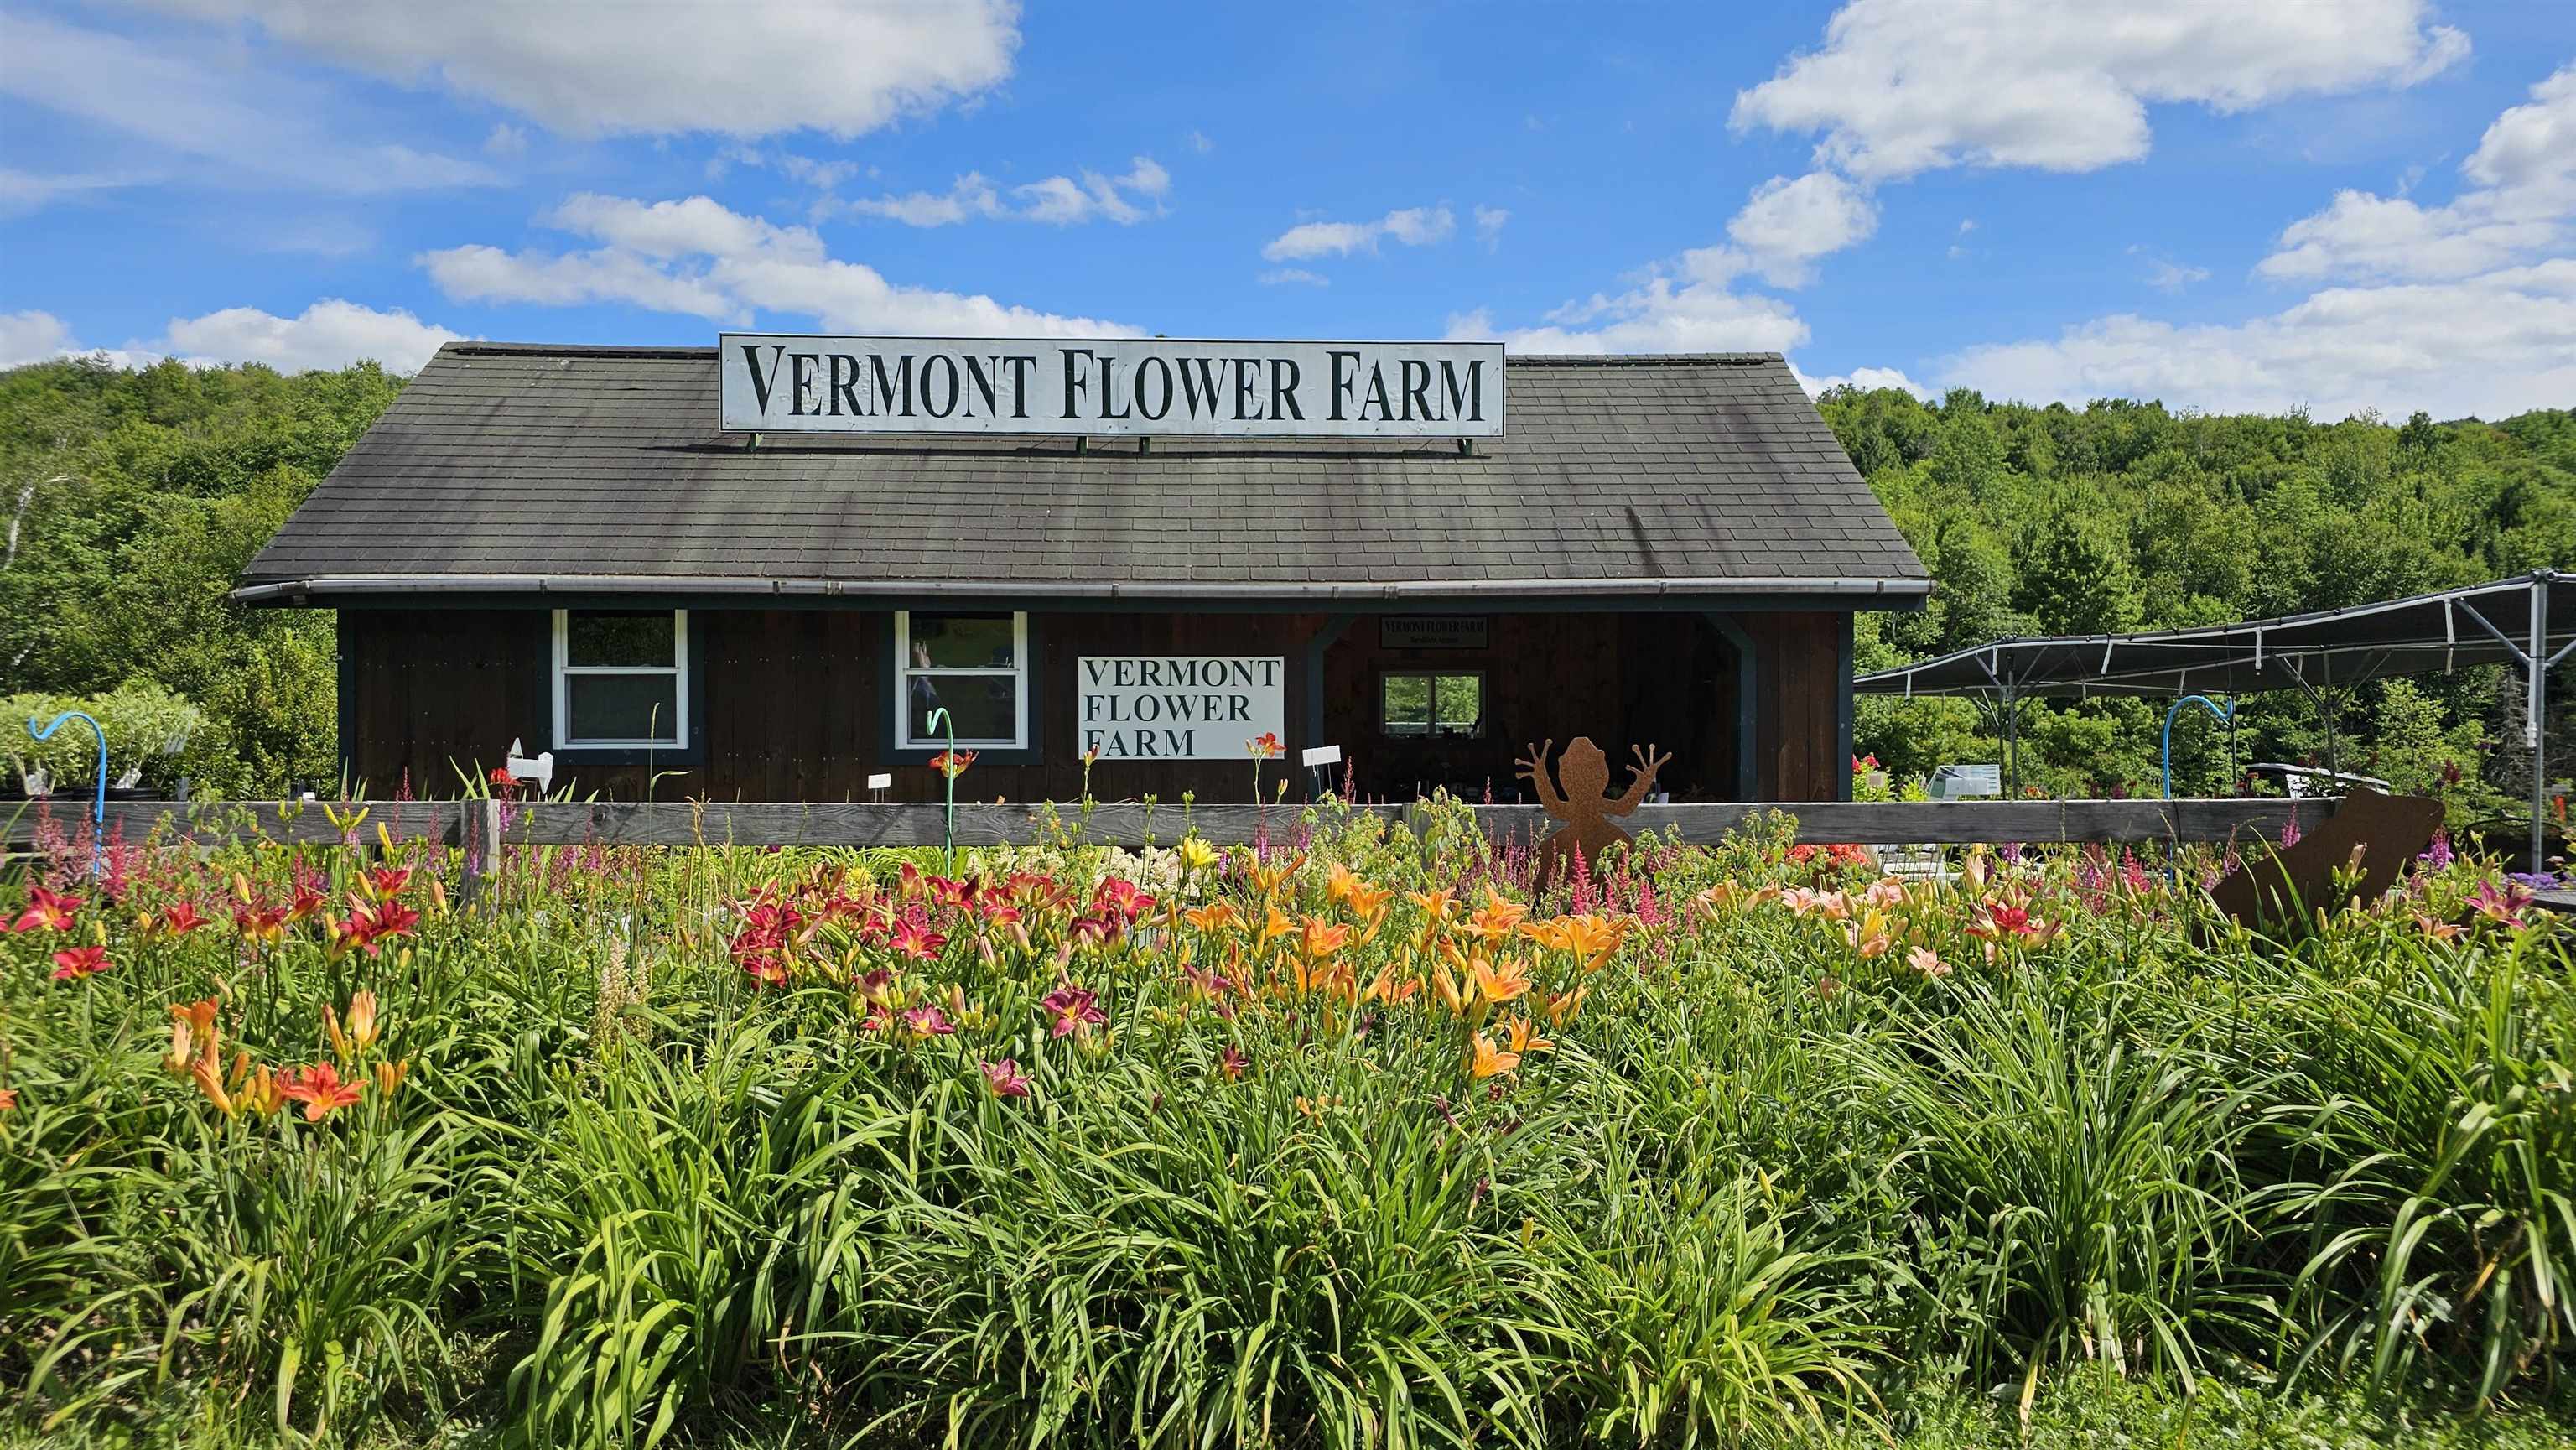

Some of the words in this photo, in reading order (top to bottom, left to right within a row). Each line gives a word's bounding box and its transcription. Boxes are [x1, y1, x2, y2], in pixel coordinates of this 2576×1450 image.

[740, 345, 1037, 418] VERMONT
[1058, 348, 1306, 421] FLOWER
[1325, 351, 1486, 422] FARM
[1083, 659, 1280, 687] VERMONT
[1083, 694, 1253, 722] FLOWER
[1083, 729, 1196, 756] FARM
